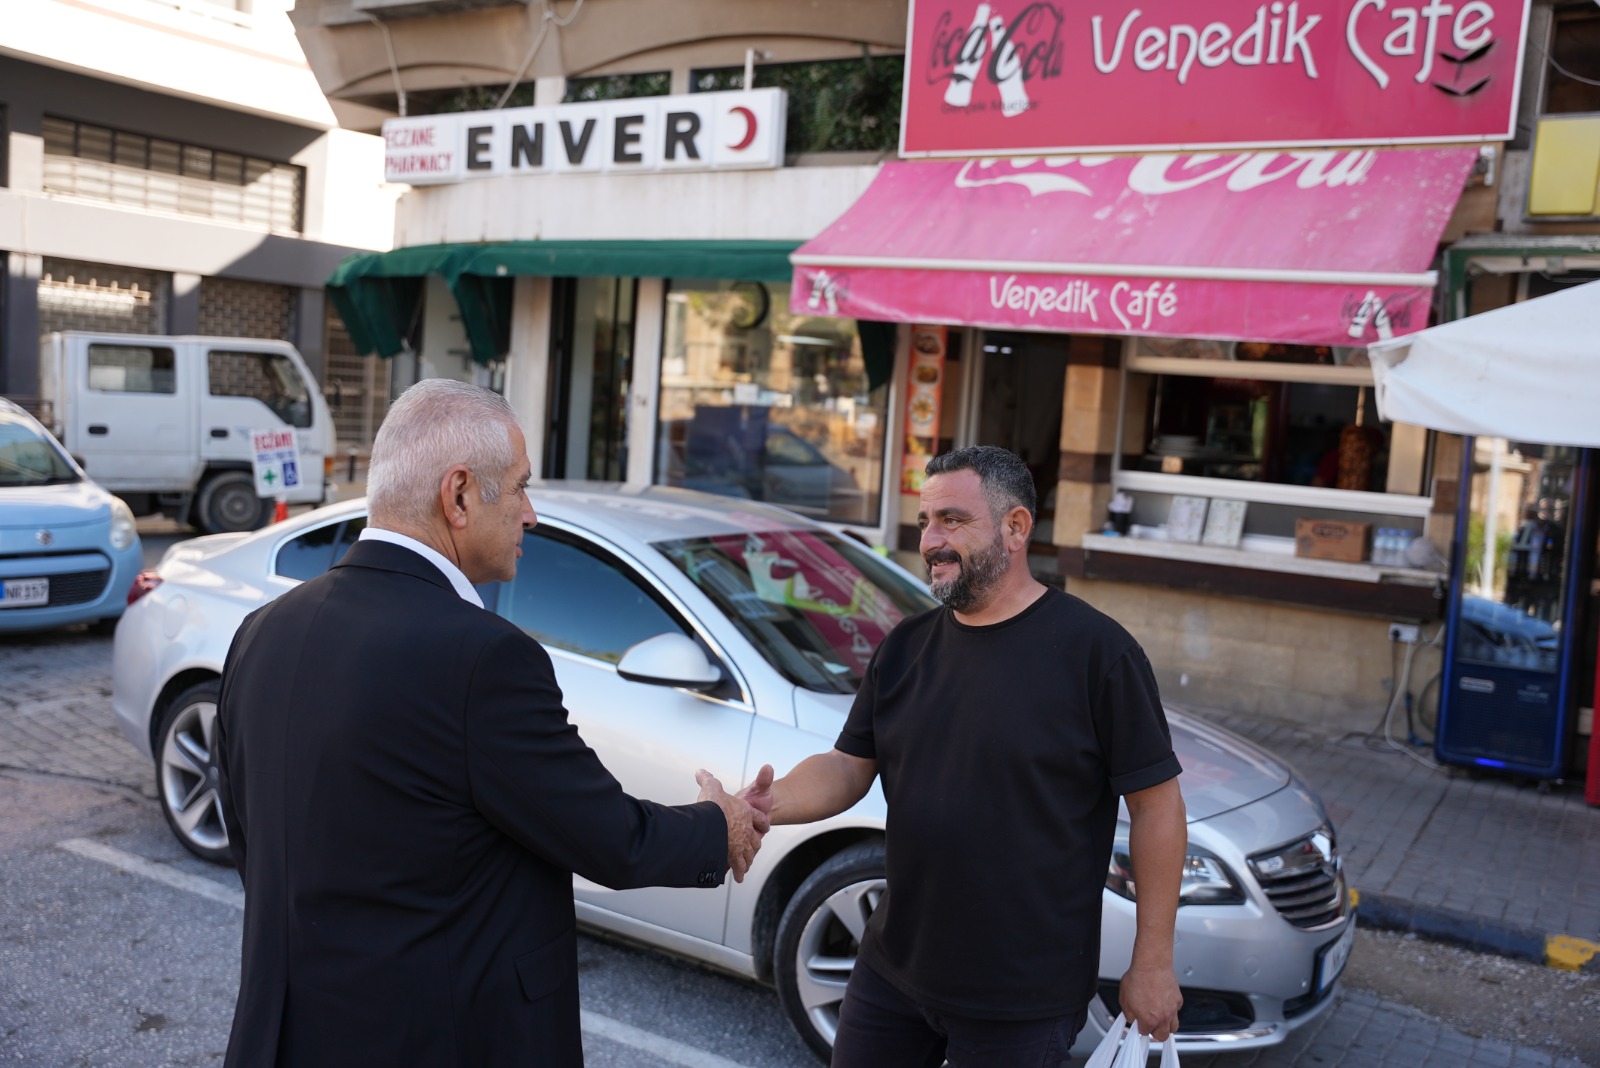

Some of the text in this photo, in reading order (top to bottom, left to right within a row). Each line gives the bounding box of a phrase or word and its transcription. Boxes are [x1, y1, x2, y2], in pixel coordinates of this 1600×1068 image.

[1091, 1, 1322, 84] Venedik
[385, 127, 436, 149] ECZANE
[385, 152, 453, 175] PHARMACY
[466, 111, 703, 170] ENVER
[989, 275, 1178, 330] Venedik Café
